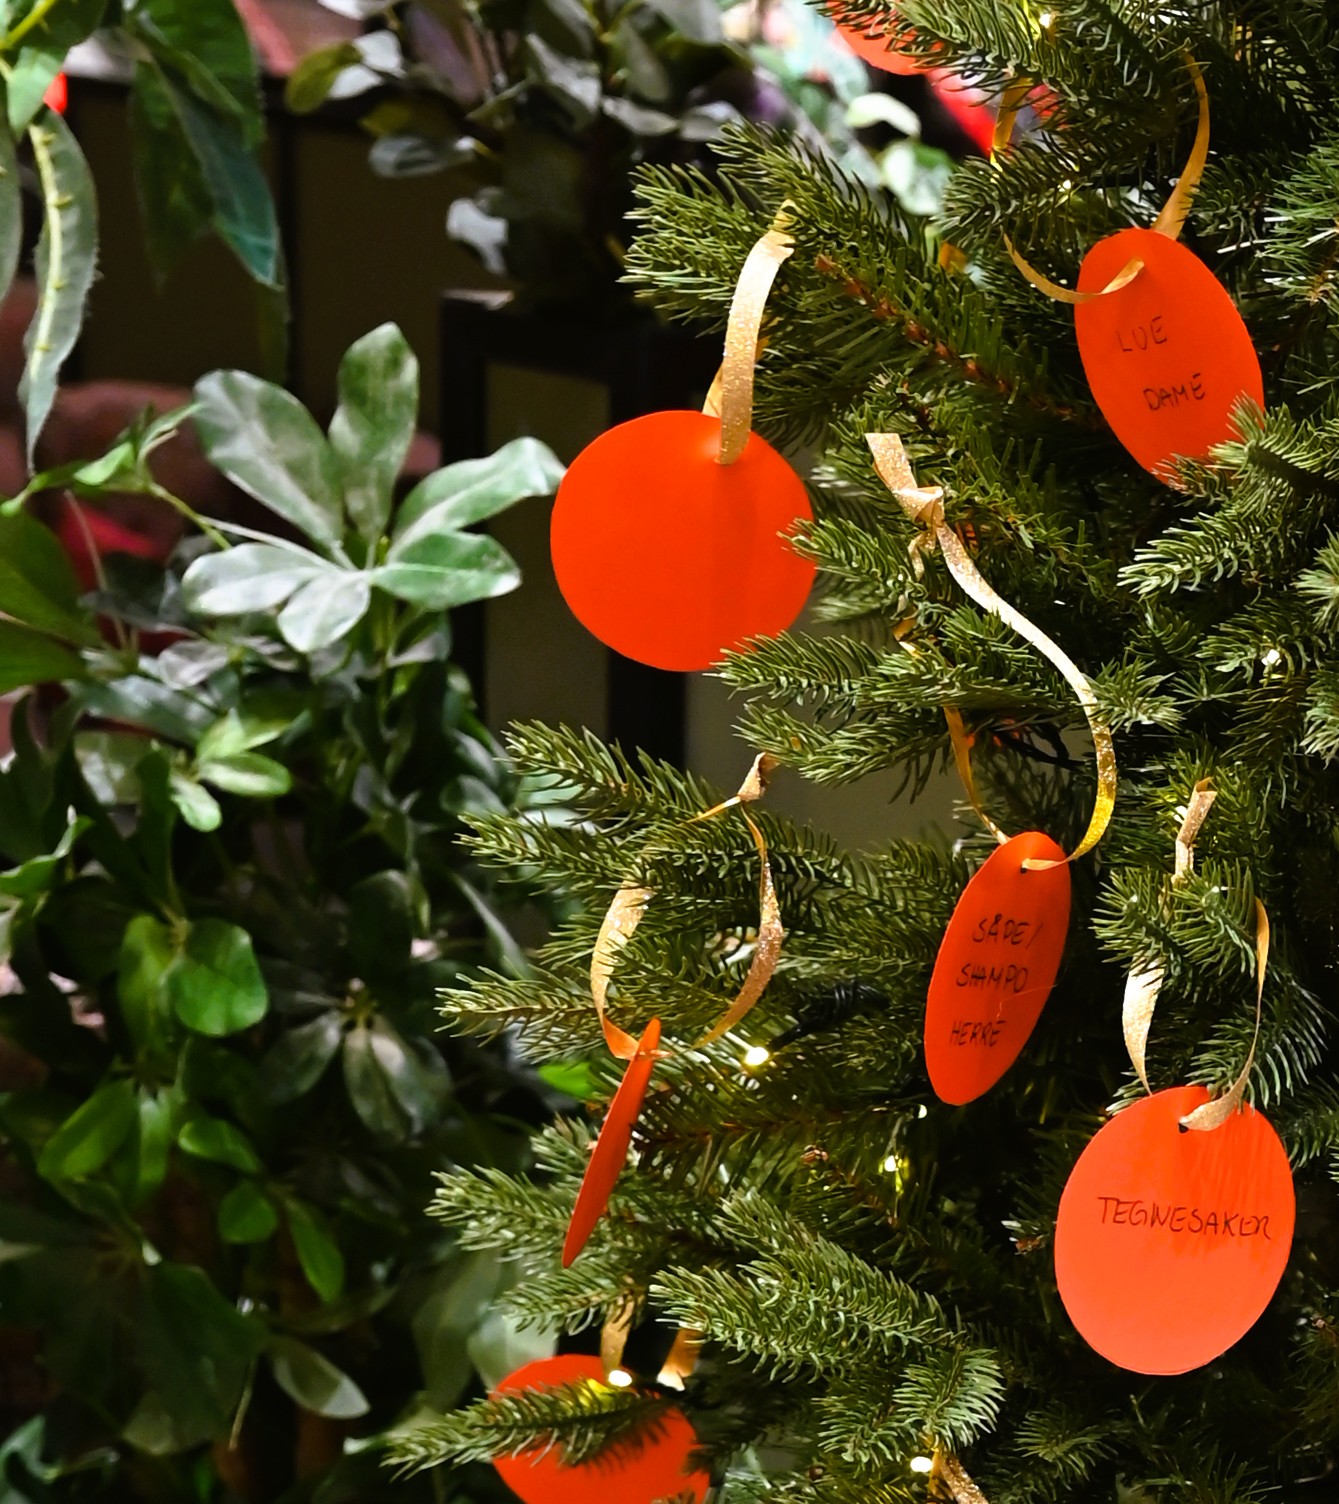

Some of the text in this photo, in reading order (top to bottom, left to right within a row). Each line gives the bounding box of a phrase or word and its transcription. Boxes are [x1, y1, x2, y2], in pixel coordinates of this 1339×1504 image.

[1115, 315, 1168, 353] LUE
[1143, 372, 1206, 411] DAME
[956, 963, 1029, 994] SHAMPO
[952, 1020, 1006, 1047] HERRE
[1098, 1196, 1272, 1241] TEGNESAKER
